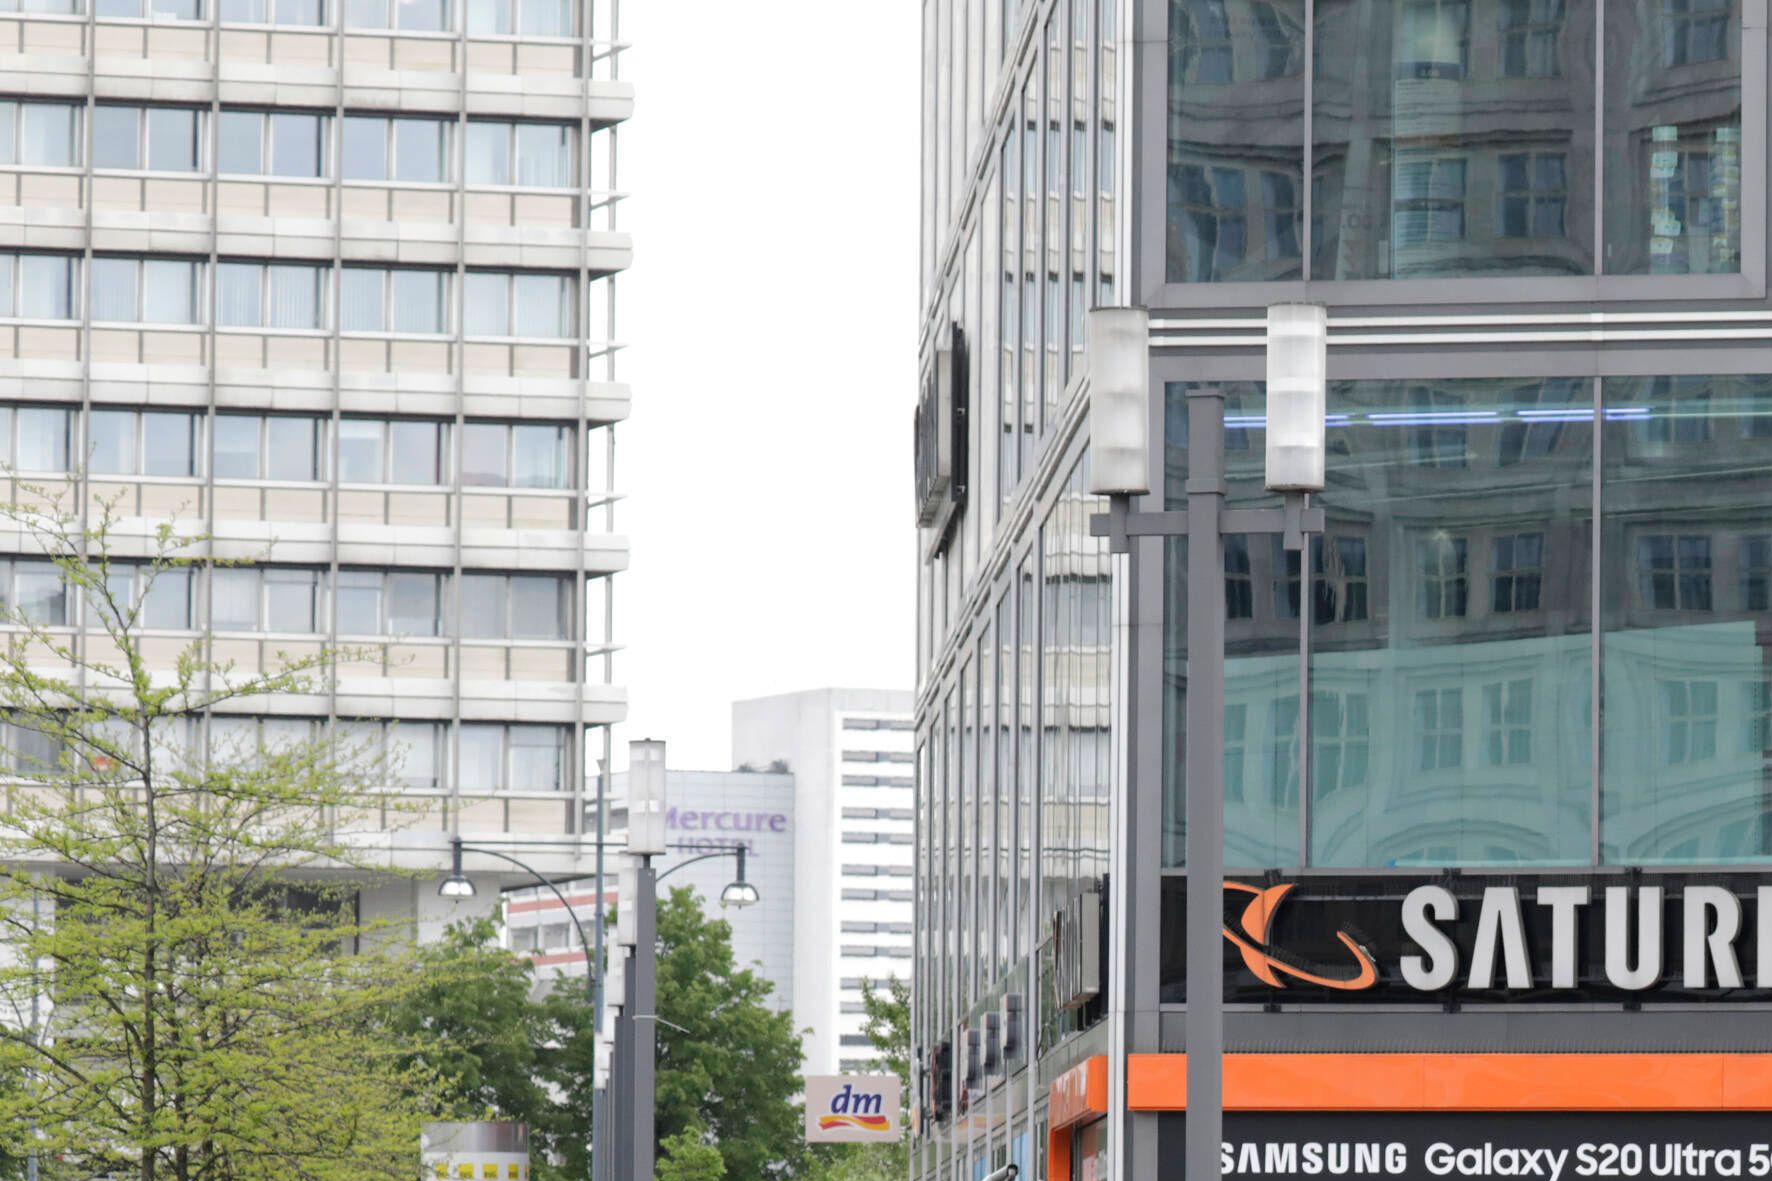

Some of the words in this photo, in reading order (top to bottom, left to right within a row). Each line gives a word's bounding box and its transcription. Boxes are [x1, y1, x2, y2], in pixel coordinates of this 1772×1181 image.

[831, 1084, 882, 1114] dm
[1221, 1142, 1407, 1175] SAMSUNG
[1575, 1142, 1643, 1177] S20
[1648, 1142, 1742, 1177] Ultra
